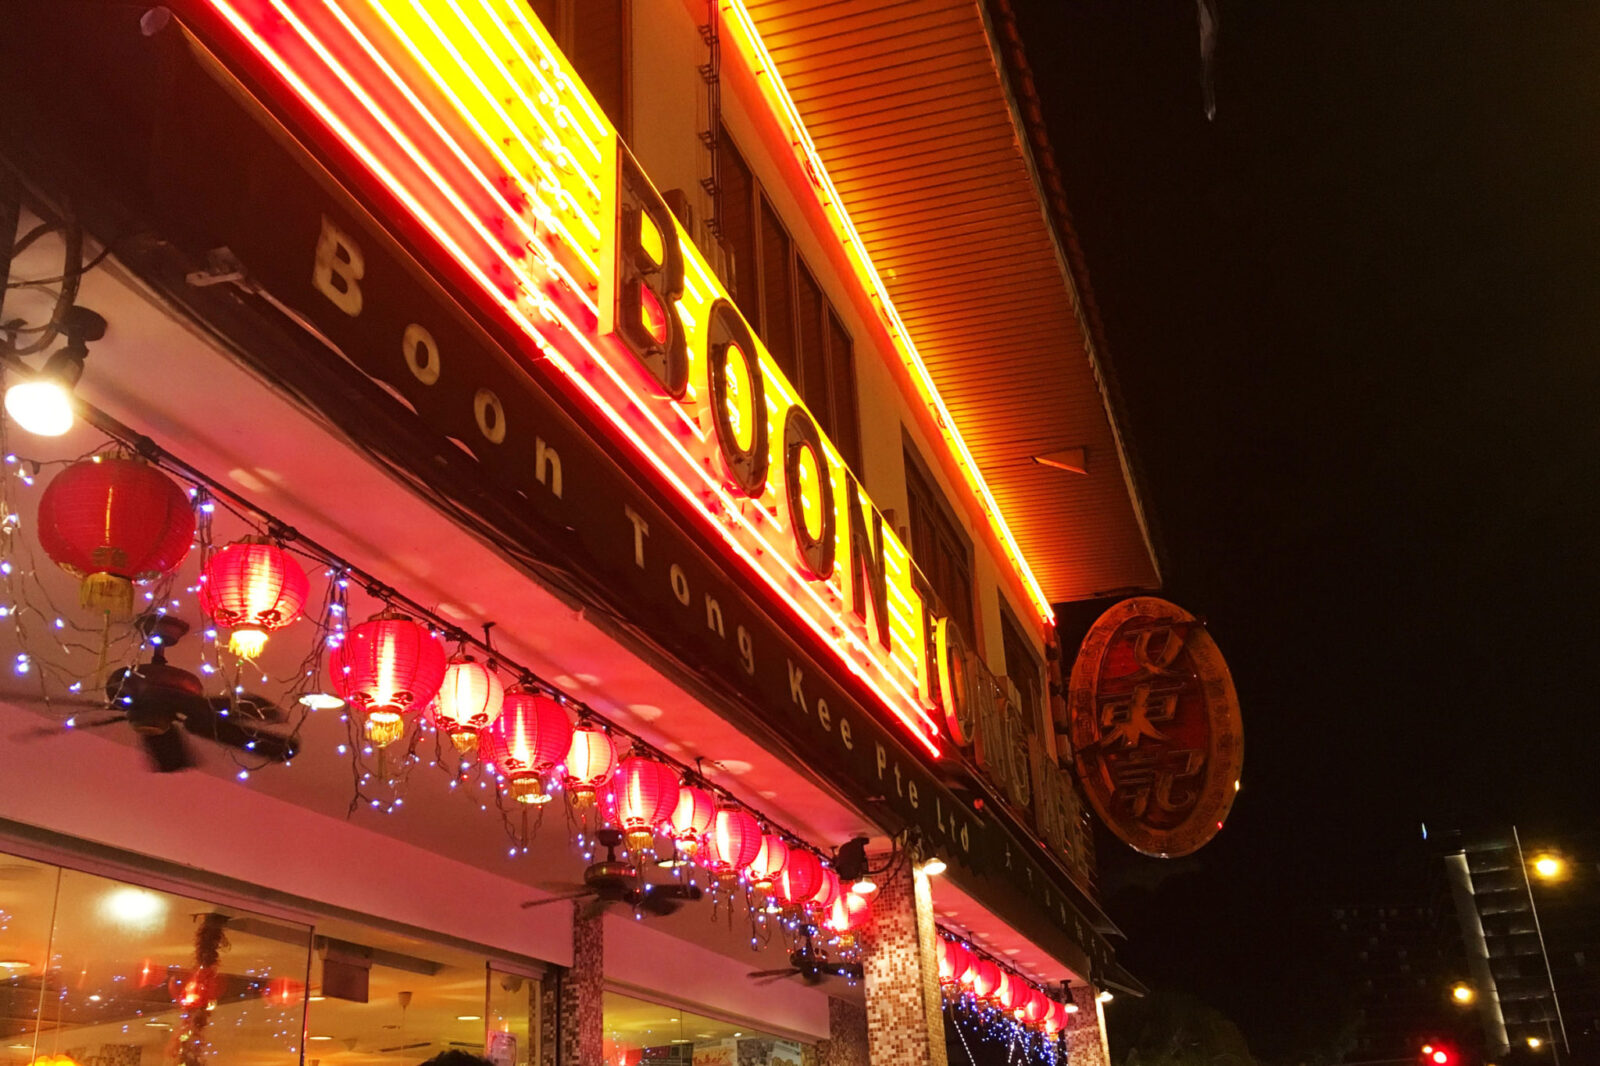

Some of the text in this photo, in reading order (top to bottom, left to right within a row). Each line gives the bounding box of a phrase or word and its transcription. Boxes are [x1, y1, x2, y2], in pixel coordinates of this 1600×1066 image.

[311, 212, 563, 500] Boon
[624, 503, 755, 676] Tong
[787, 658, 853, 750] Kee
[875, 740, 919, 809] Pte
[936, 797, 970, 853] Ltd
[615, 139, 891, 654] BOON
